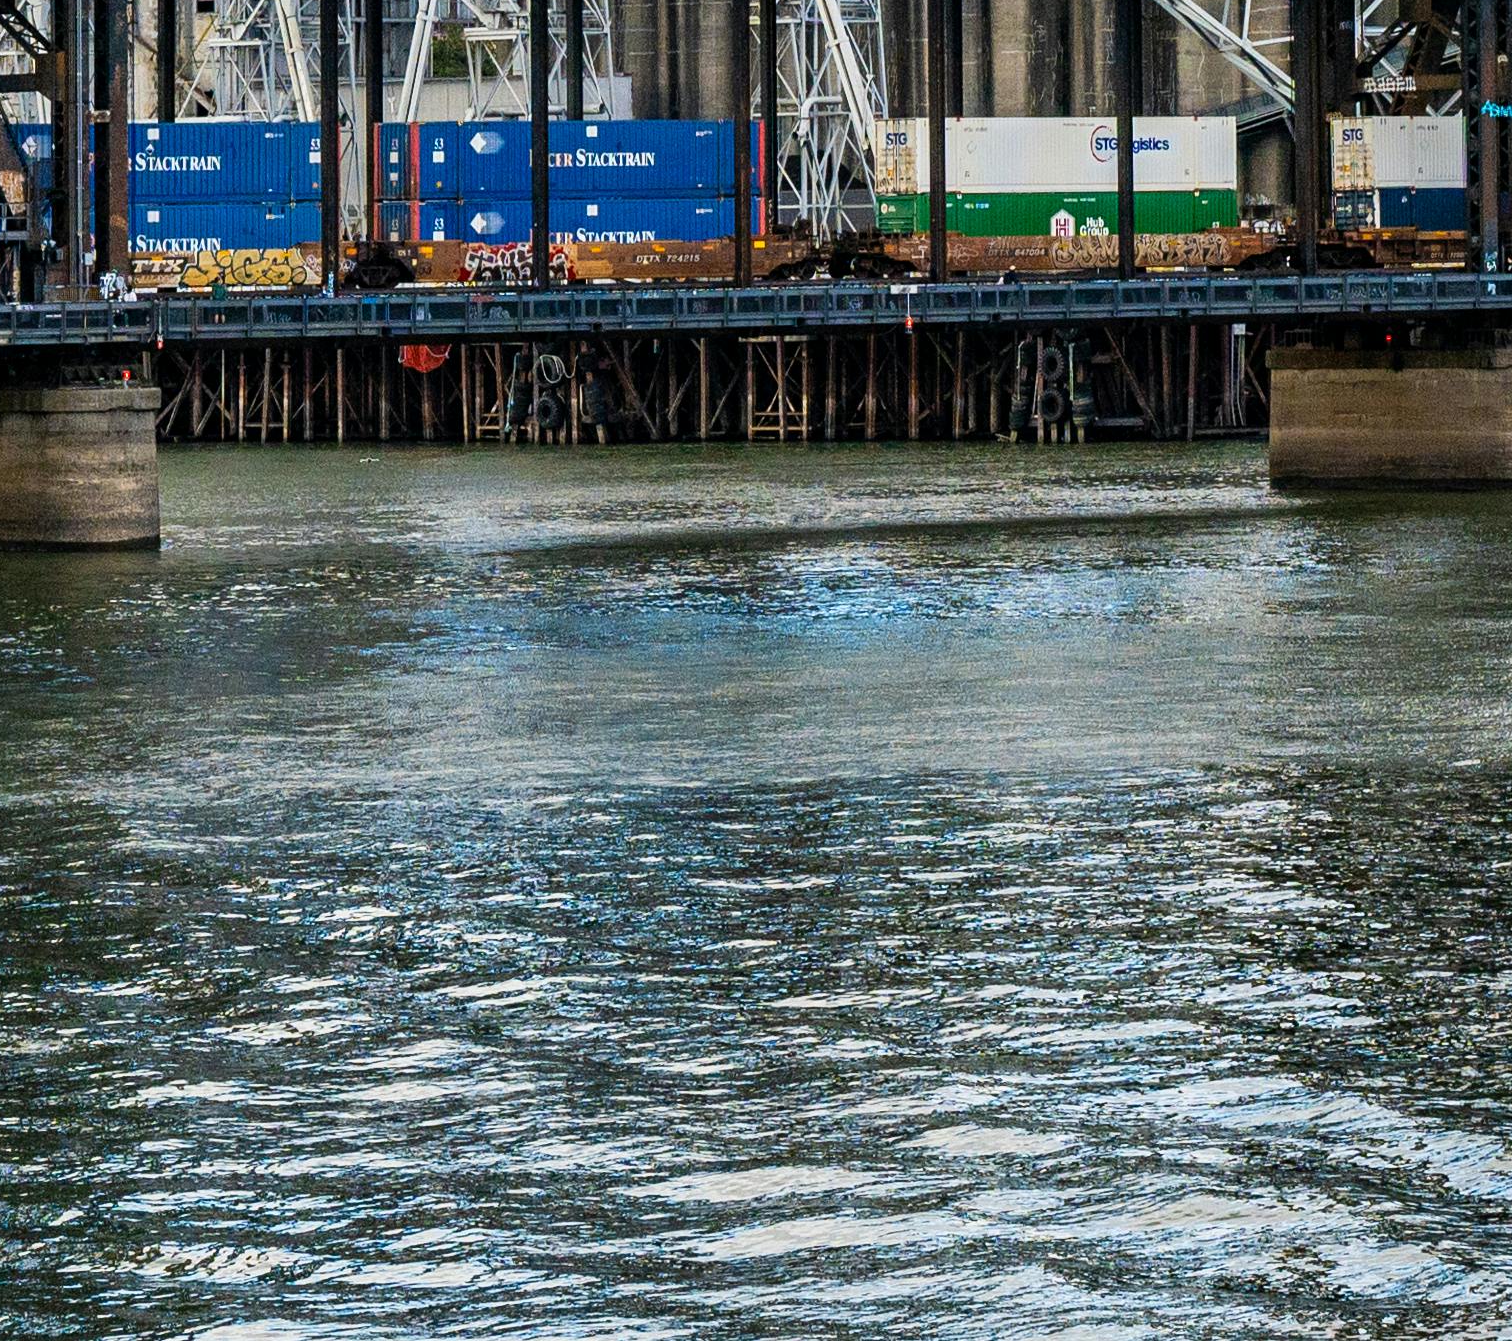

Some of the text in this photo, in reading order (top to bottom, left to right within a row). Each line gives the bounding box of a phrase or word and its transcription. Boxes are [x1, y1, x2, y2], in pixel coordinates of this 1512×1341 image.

[886, 132, 908, 146] STG
[1342, 128, 1364, 142] STG
[310, 138, 321, 150] 53
[435, 138, 445, 150] 53
[435, 218, 445, 230] 53
[1086, 216, 1105, 228] Hub
[665, 254, 701, 263] 724215
[131, 259, 189, 274] TTX
